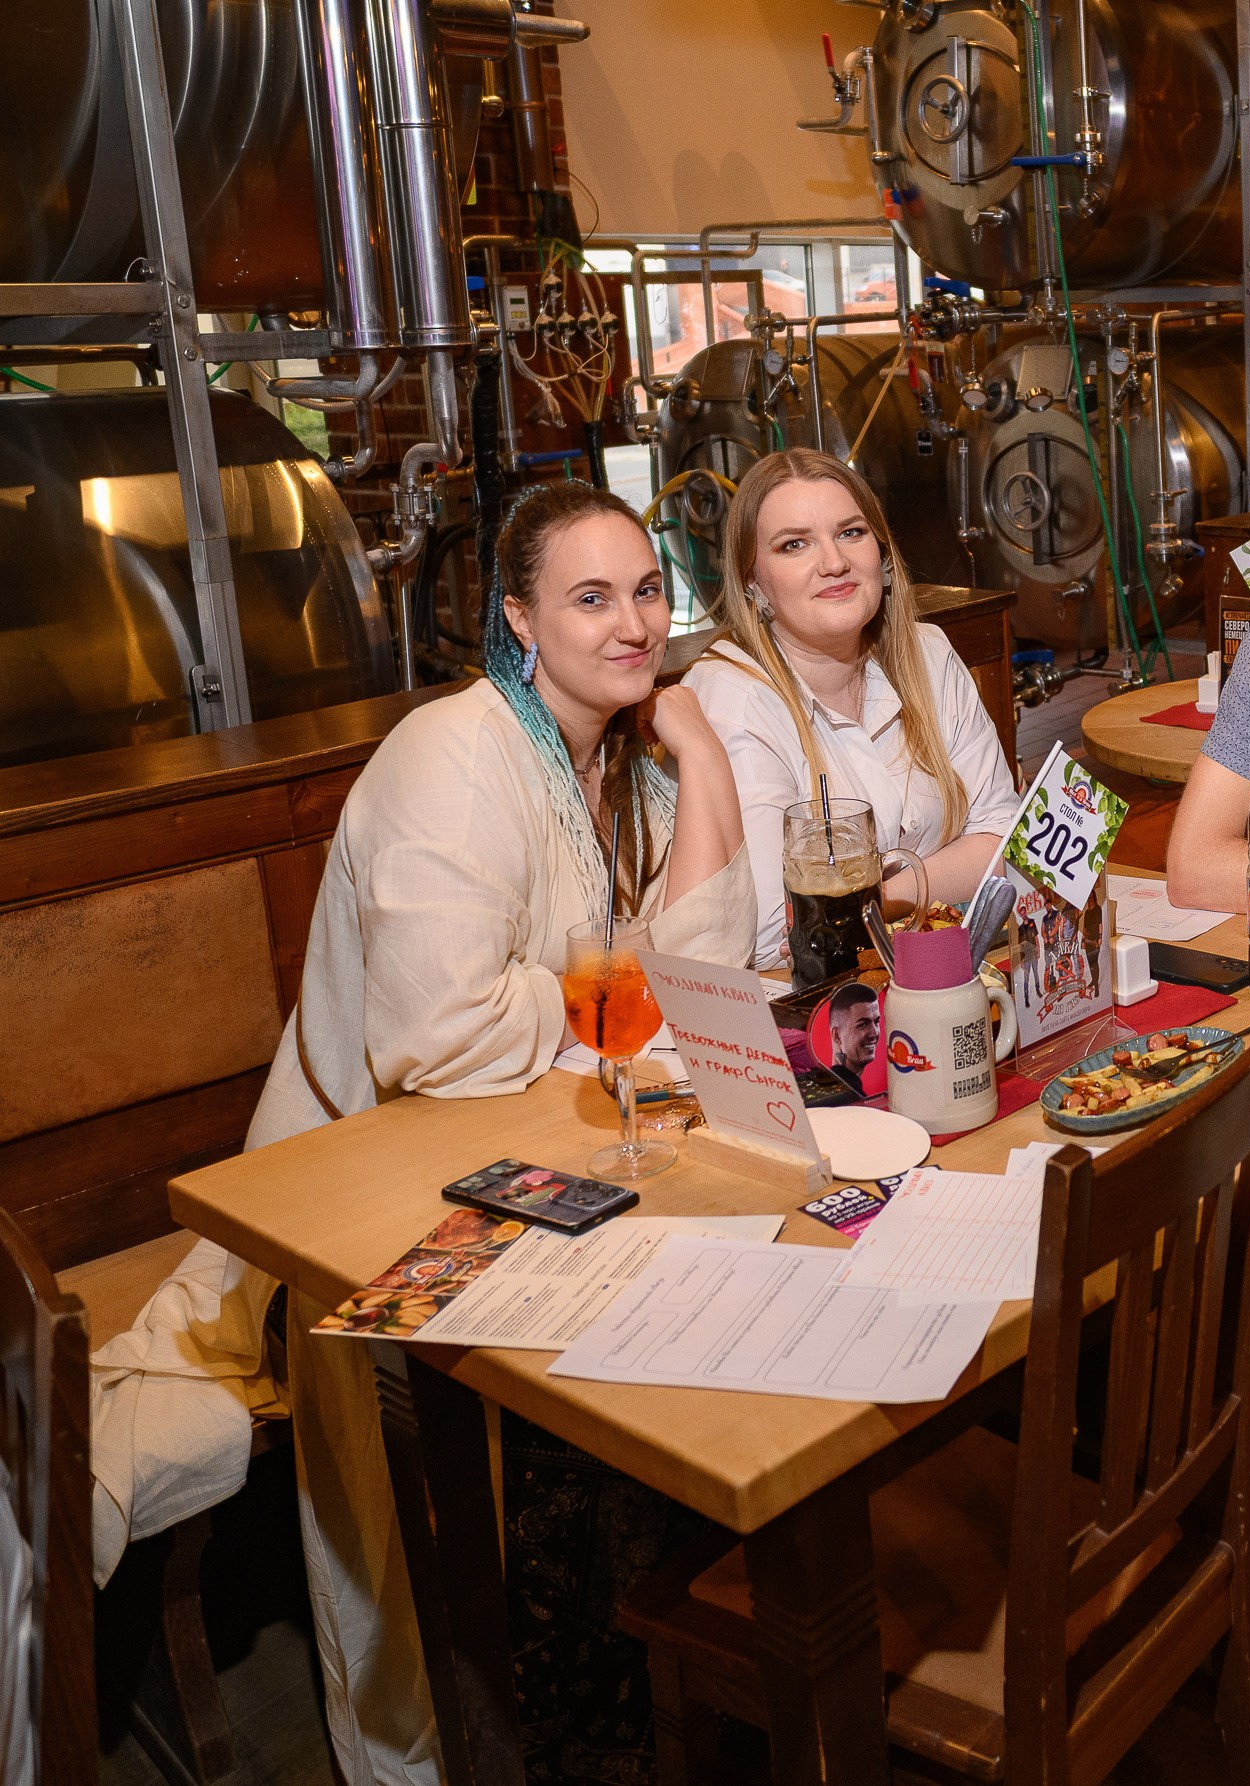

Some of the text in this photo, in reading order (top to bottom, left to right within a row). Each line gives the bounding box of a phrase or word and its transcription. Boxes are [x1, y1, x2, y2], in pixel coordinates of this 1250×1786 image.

[1060, 803, 1076, 822] СТОЛ
[1026, 811, 1088, 881] 202
[652, 971, 719, 997] МОДНЫЙ
[721, 987, 758, 1005] КВИЗ
[805, 1187, 861, 1213] 600
